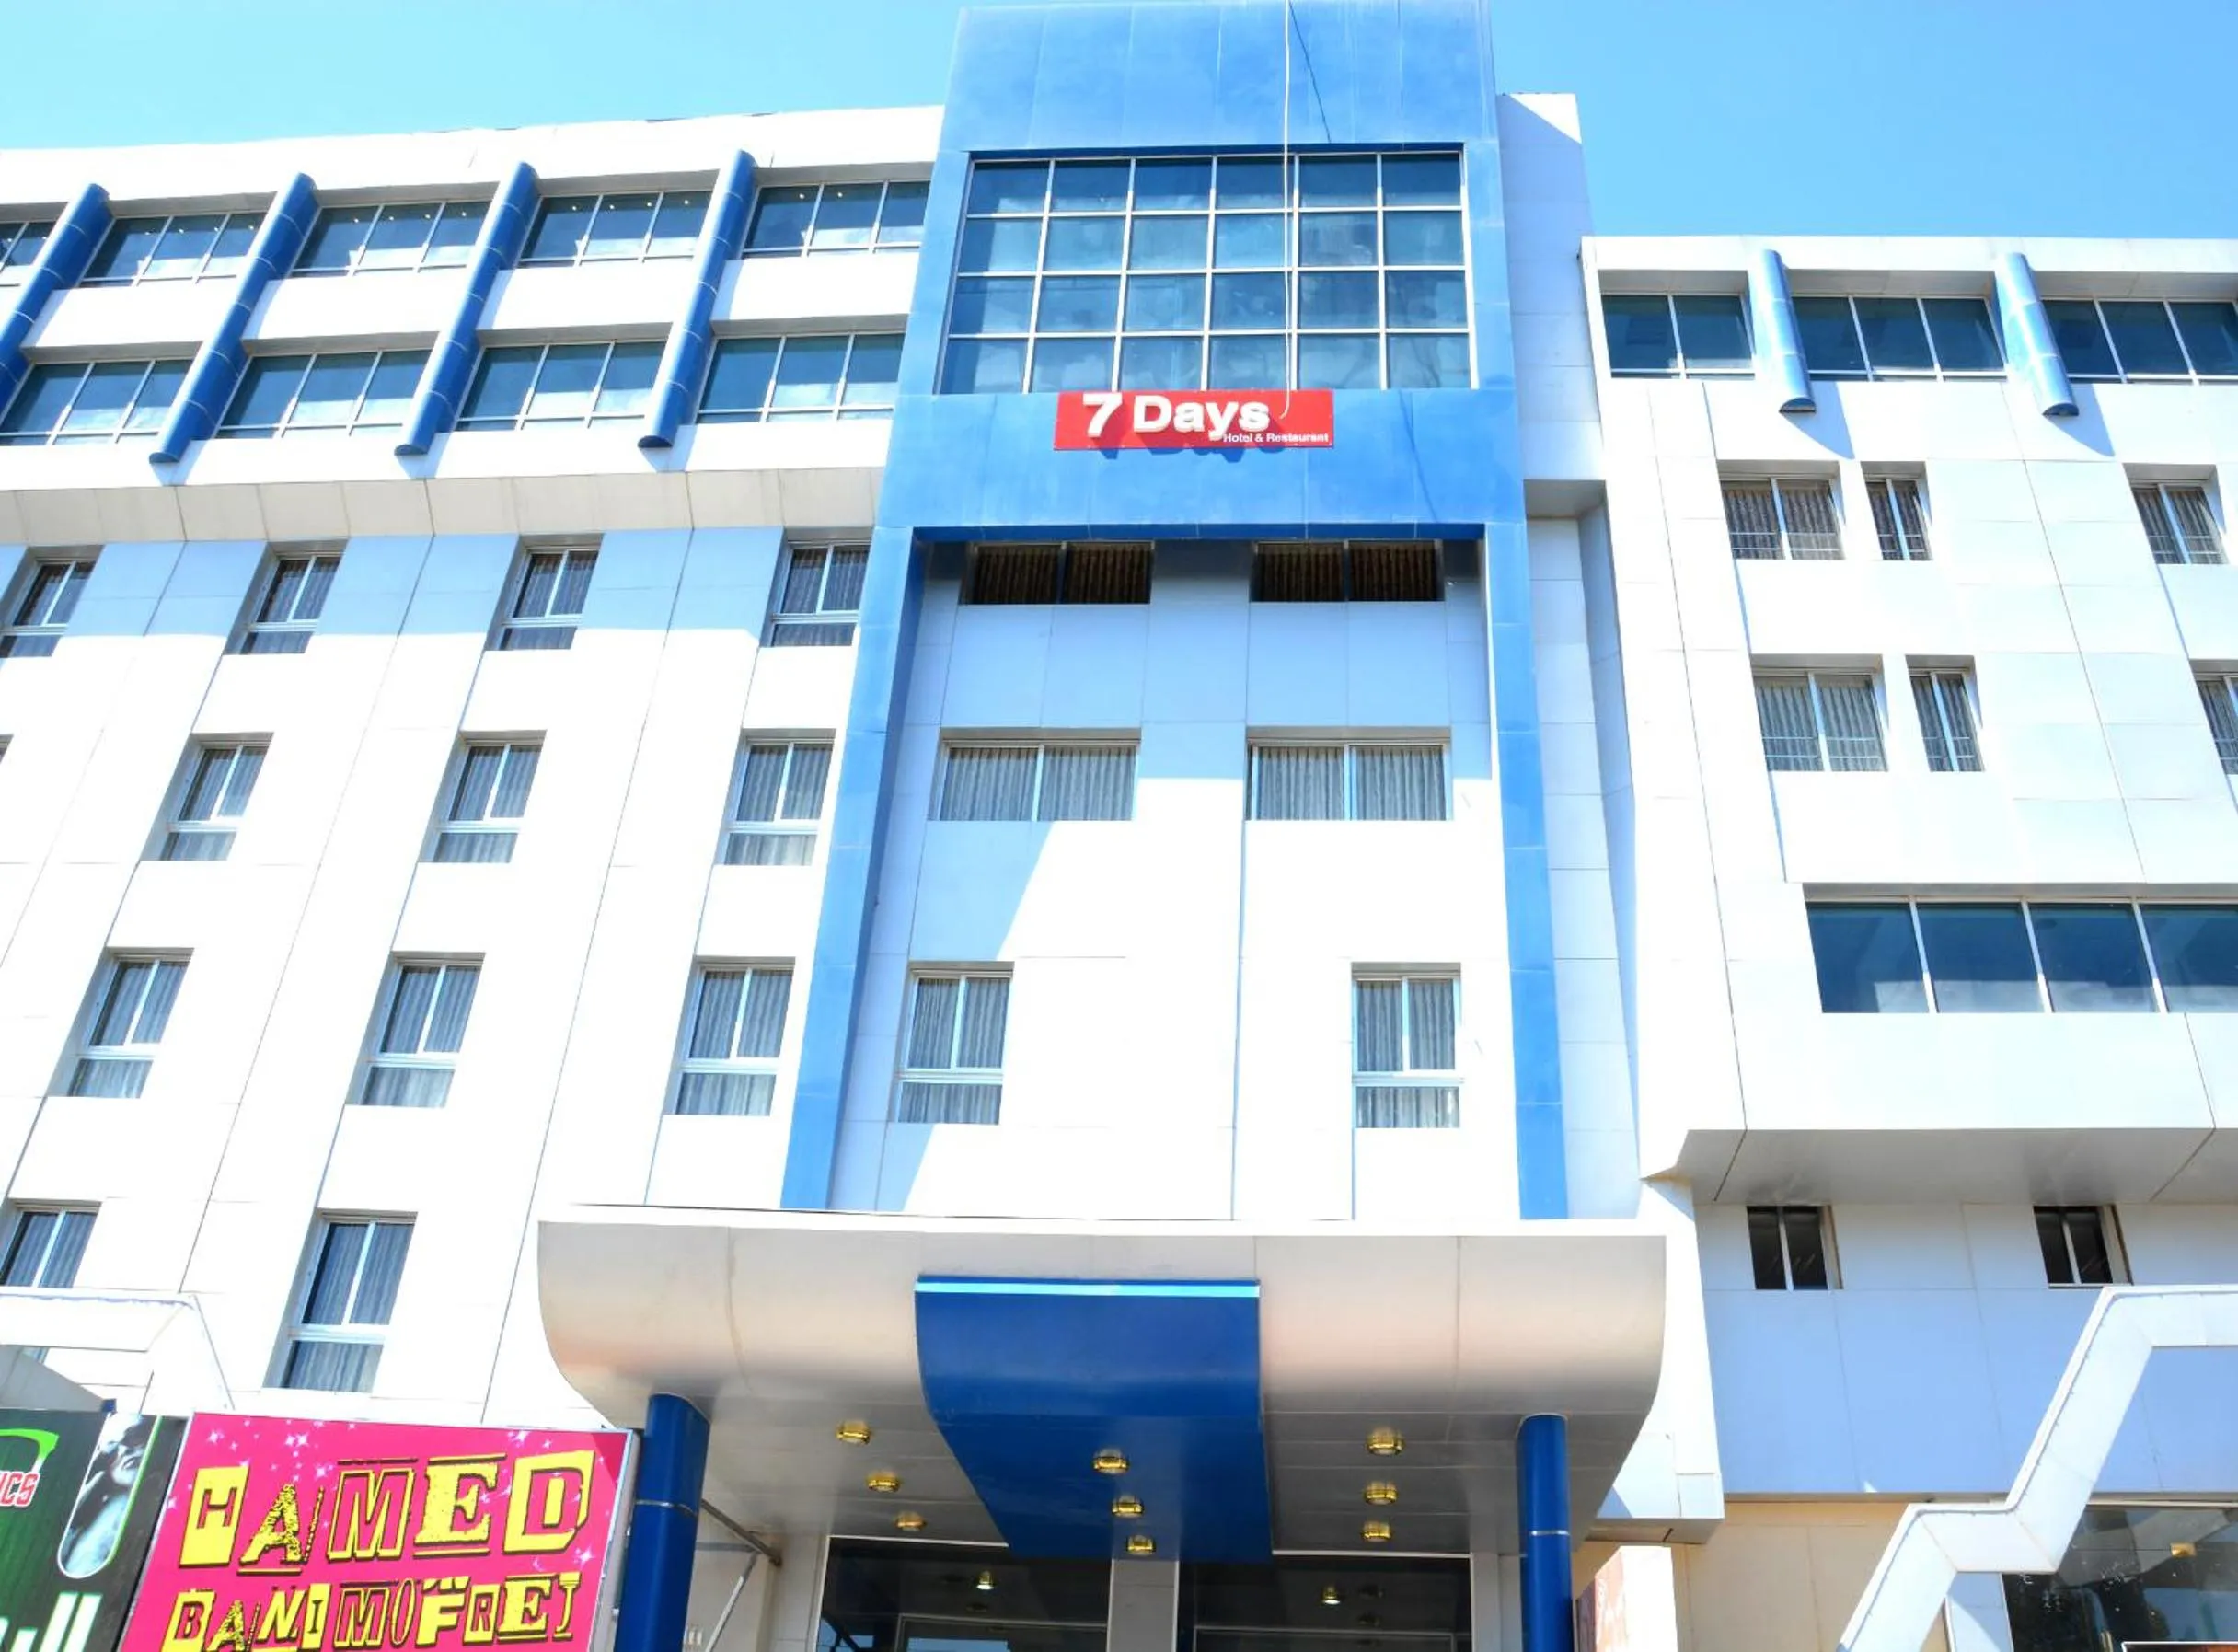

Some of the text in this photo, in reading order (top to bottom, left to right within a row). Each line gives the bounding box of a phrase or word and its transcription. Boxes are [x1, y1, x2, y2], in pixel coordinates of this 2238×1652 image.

[1083, 393, 1270, 441] 7 Days
[1223, 433, 1329, 443] Hotel & Restaurant
[179, 1450, 595, 1575] HAMED
